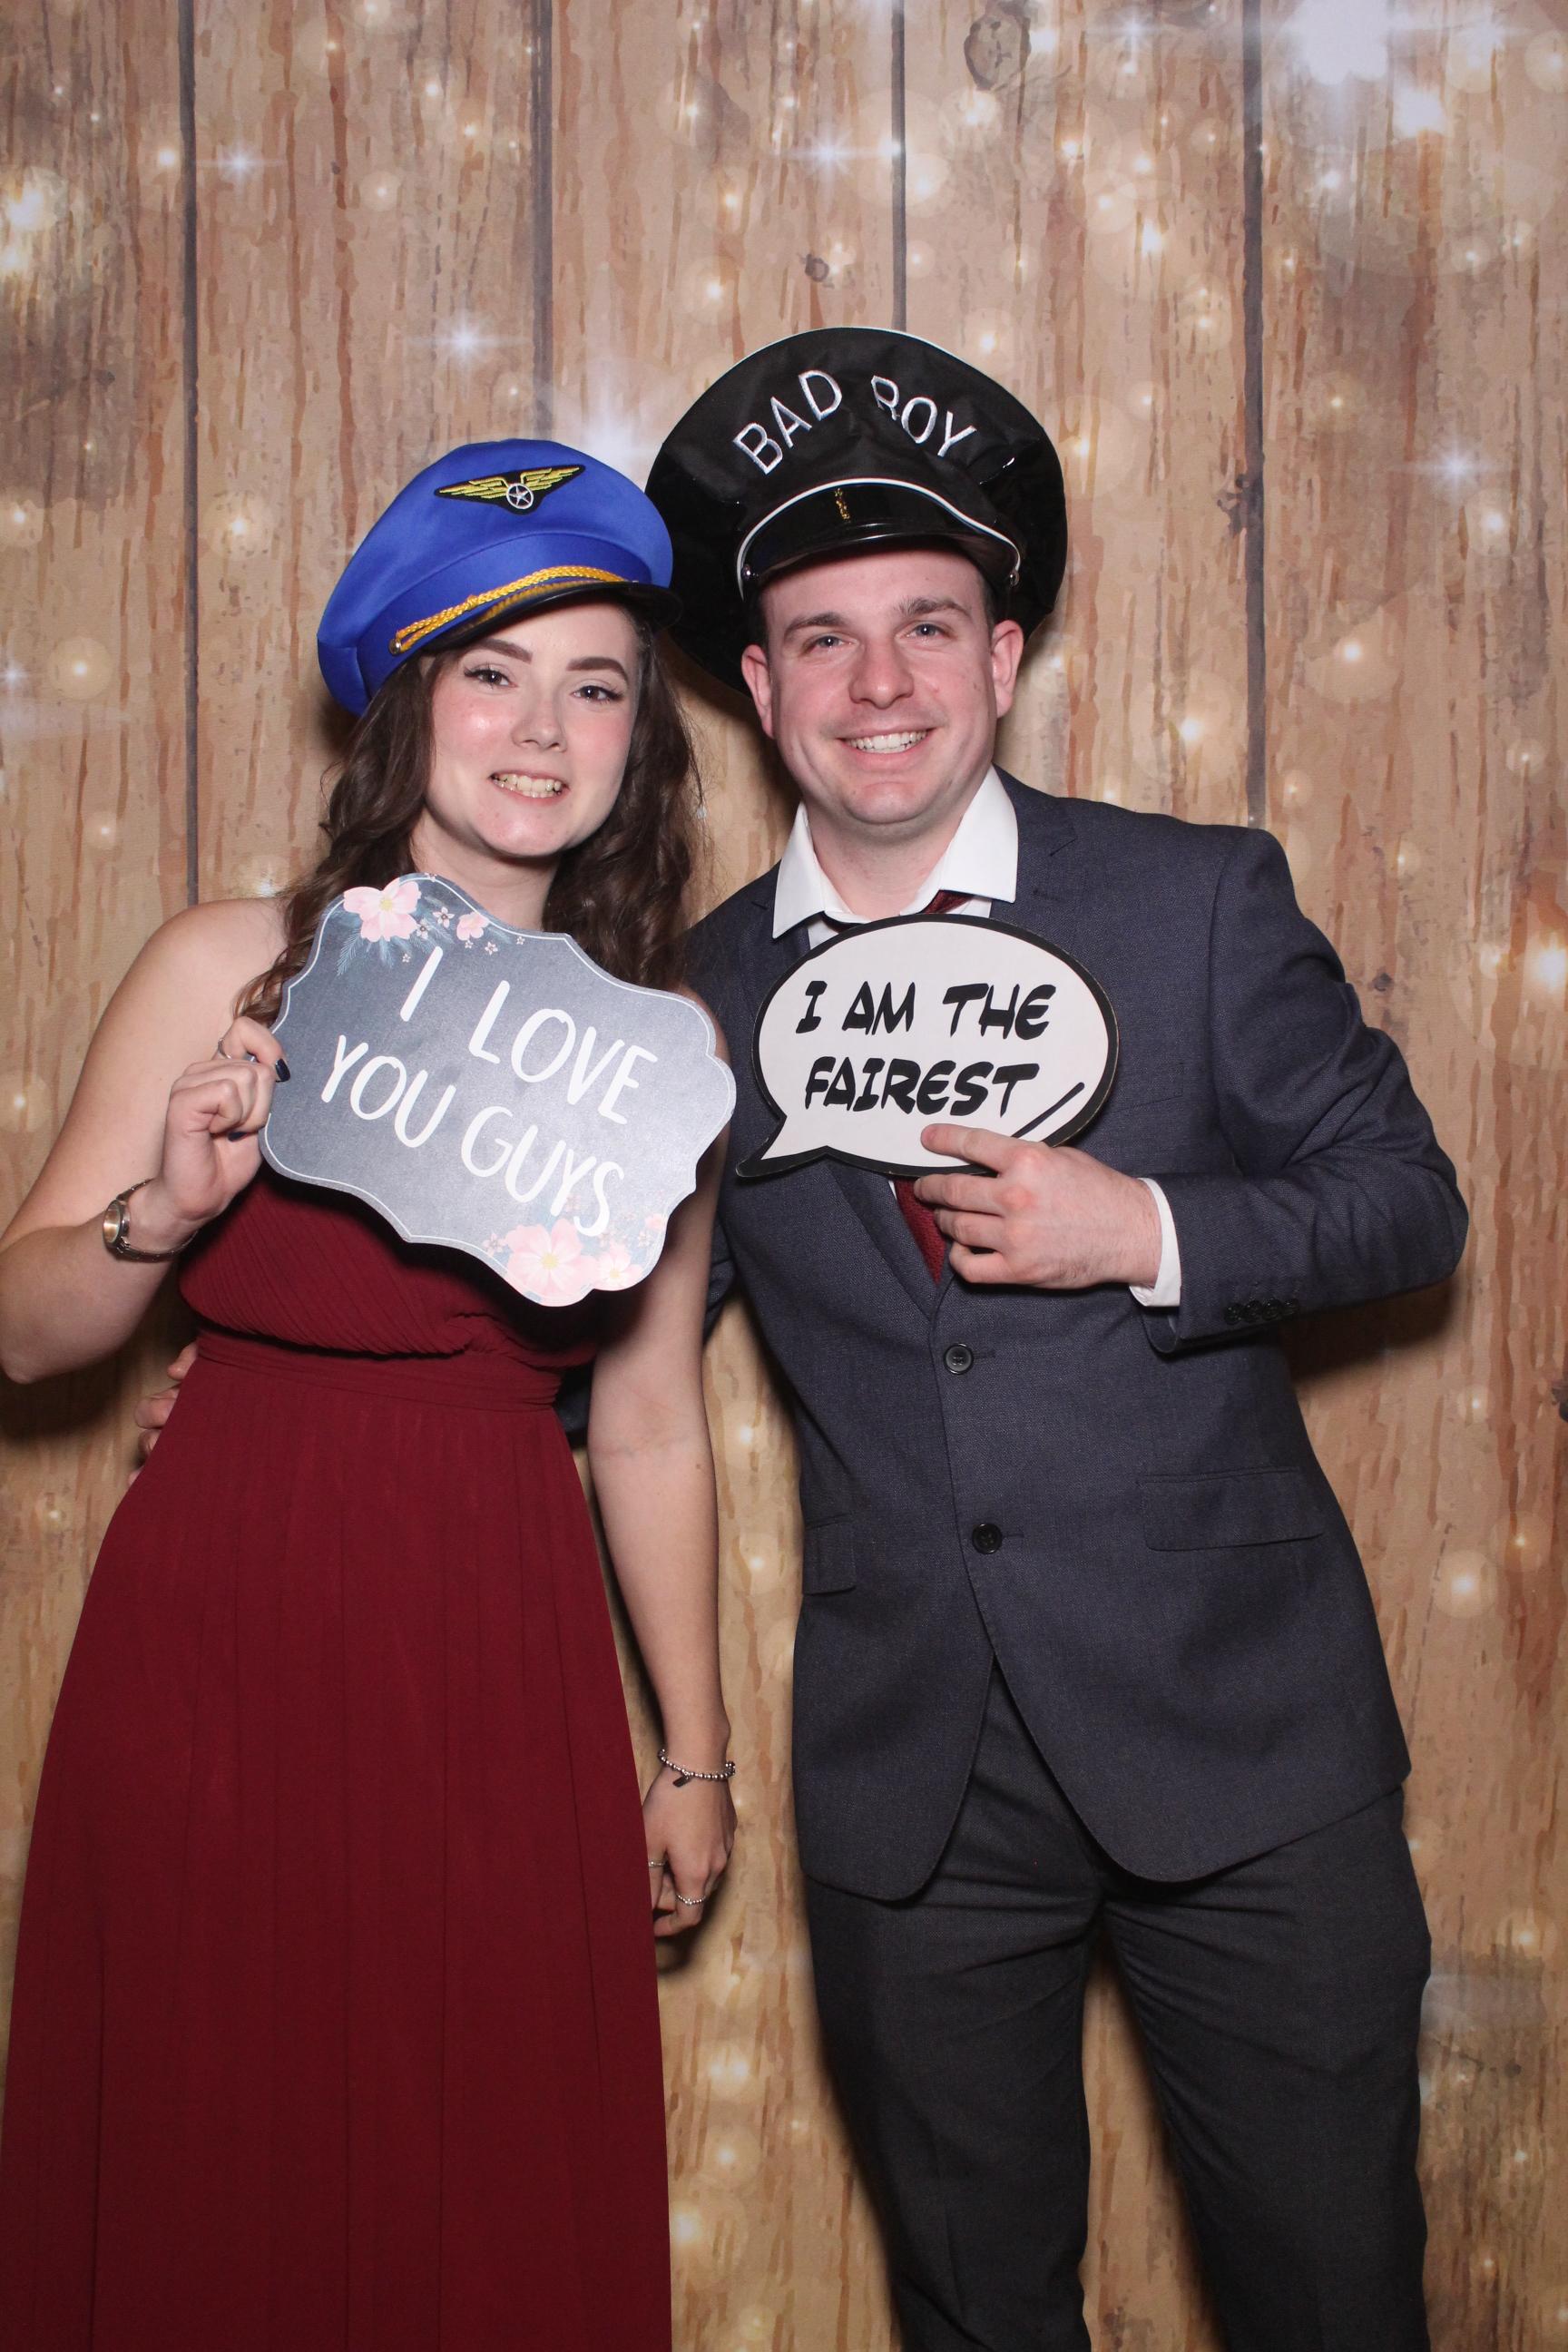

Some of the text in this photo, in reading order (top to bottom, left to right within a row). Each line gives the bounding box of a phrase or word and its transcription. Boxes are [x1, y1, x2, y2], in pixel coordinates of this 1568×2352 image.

[732, 369, 843, 475] BAD
[400, 946, 658, 1125] I LOVE
[795, 980, 1056, 1041] I AM THE
[320, 1034, 625, 1237] YOU GUYS
[804, 1055, 1040, 1117] FAIREST
